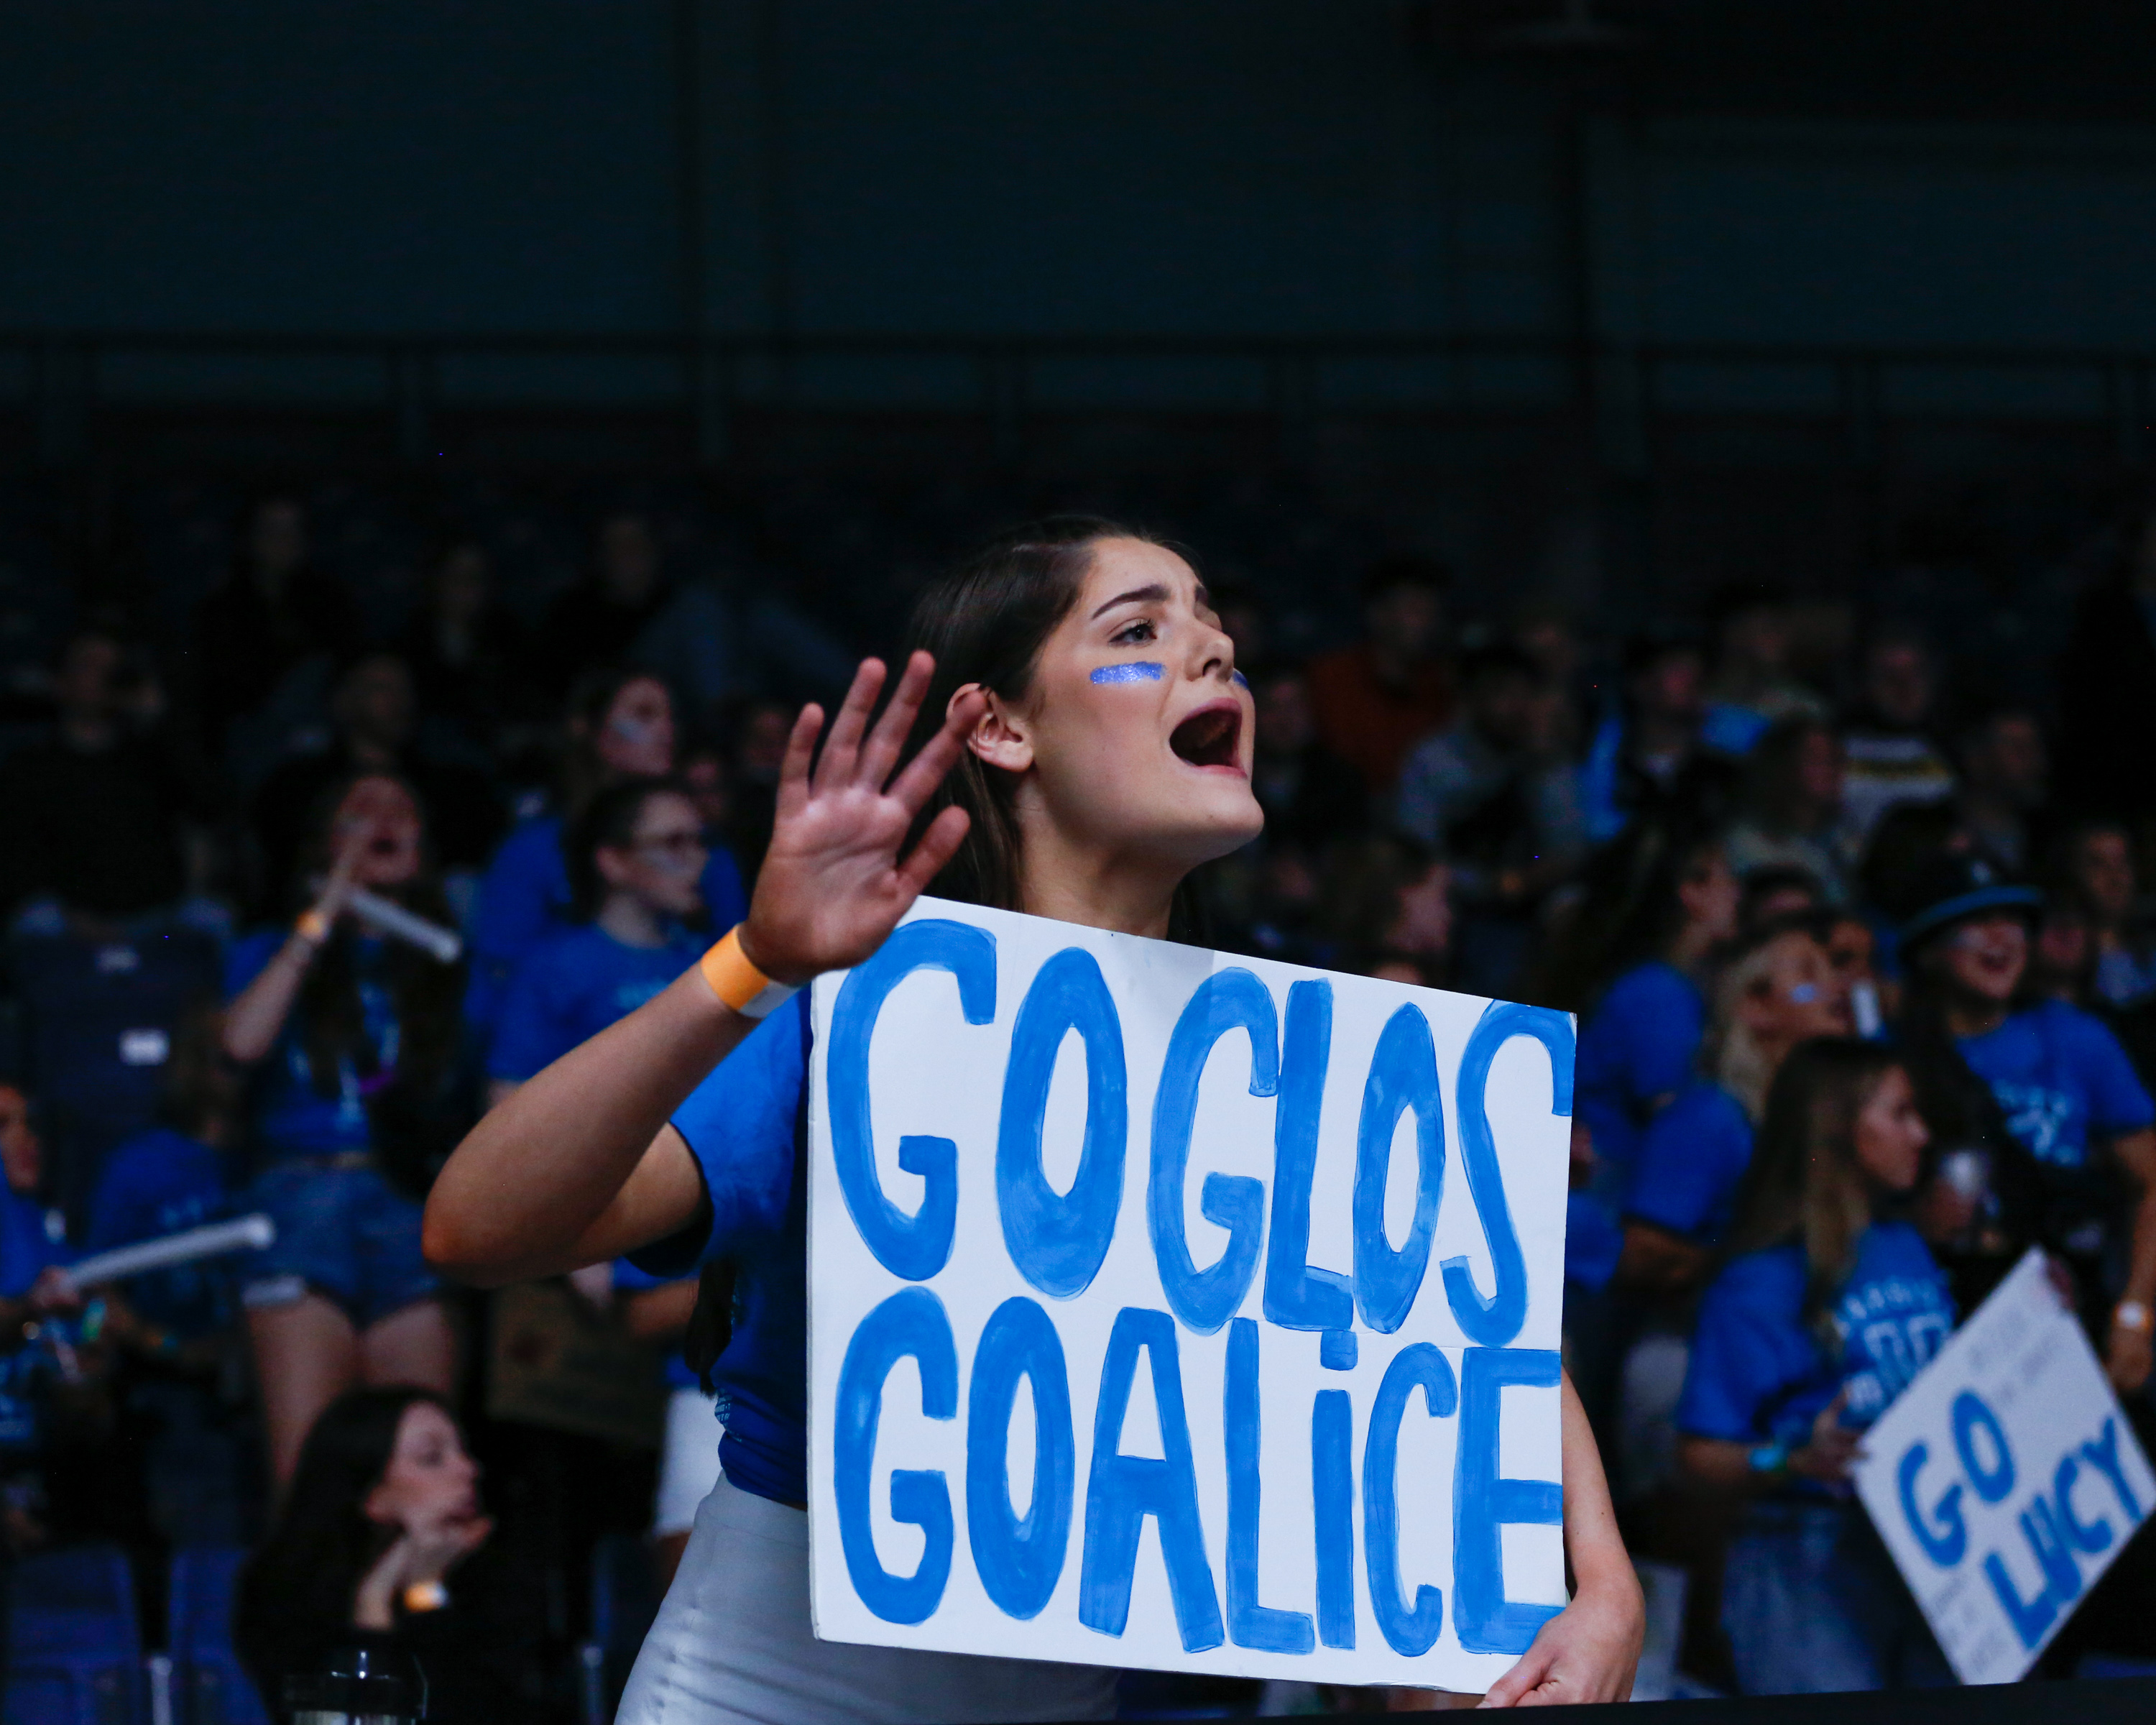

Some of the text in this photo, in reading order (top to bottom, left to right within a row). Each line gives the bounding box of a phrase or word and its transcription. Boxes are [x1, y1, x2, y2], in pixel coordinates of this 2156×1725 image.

[827, 919, 1577, 1348] GO GLOS
[834, 1285, 1075, 1627] GO
[1896, 1389, 2017, 1568] GO
[1984, 1417, 2143, 1651] LUCY
